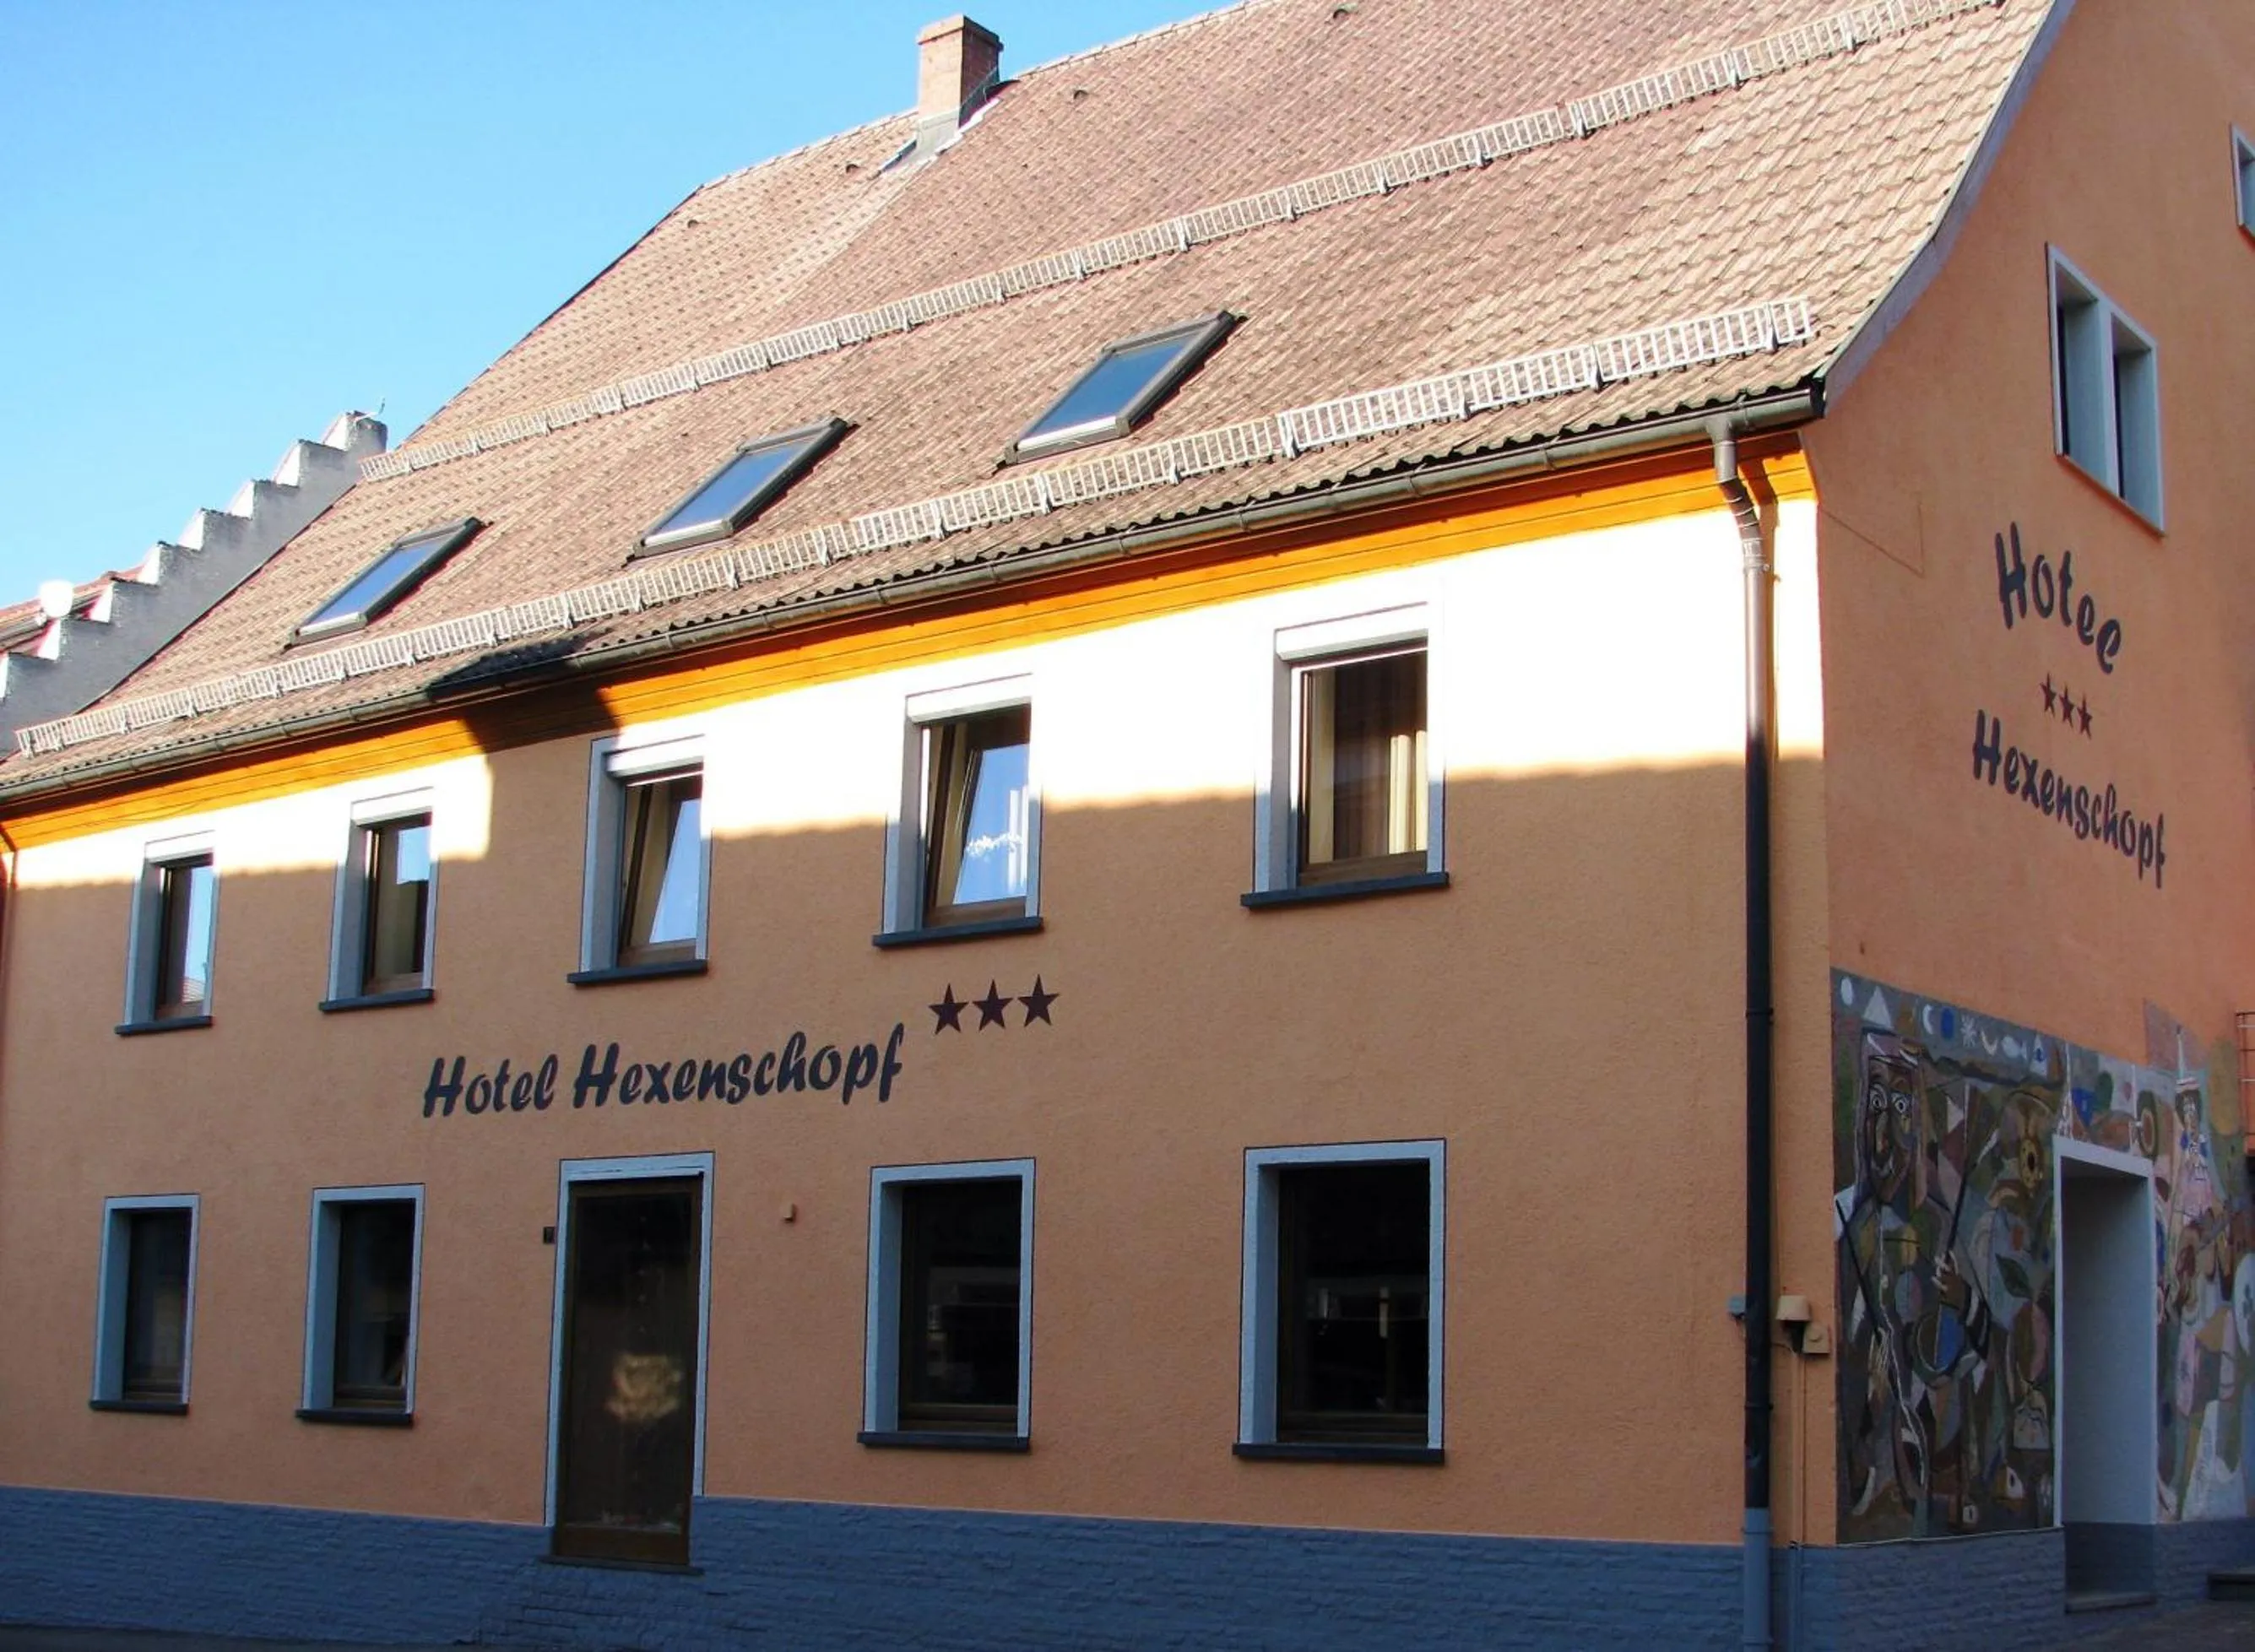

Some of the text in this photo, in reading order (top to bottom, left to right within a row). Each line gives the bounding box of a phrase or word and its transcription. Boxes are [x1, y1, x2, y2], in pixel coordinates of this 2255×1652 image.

[1971, 708, 2166, 889] Hexenschopf
[423, 1022, 904, 1118] Hotel Hexenschopf
